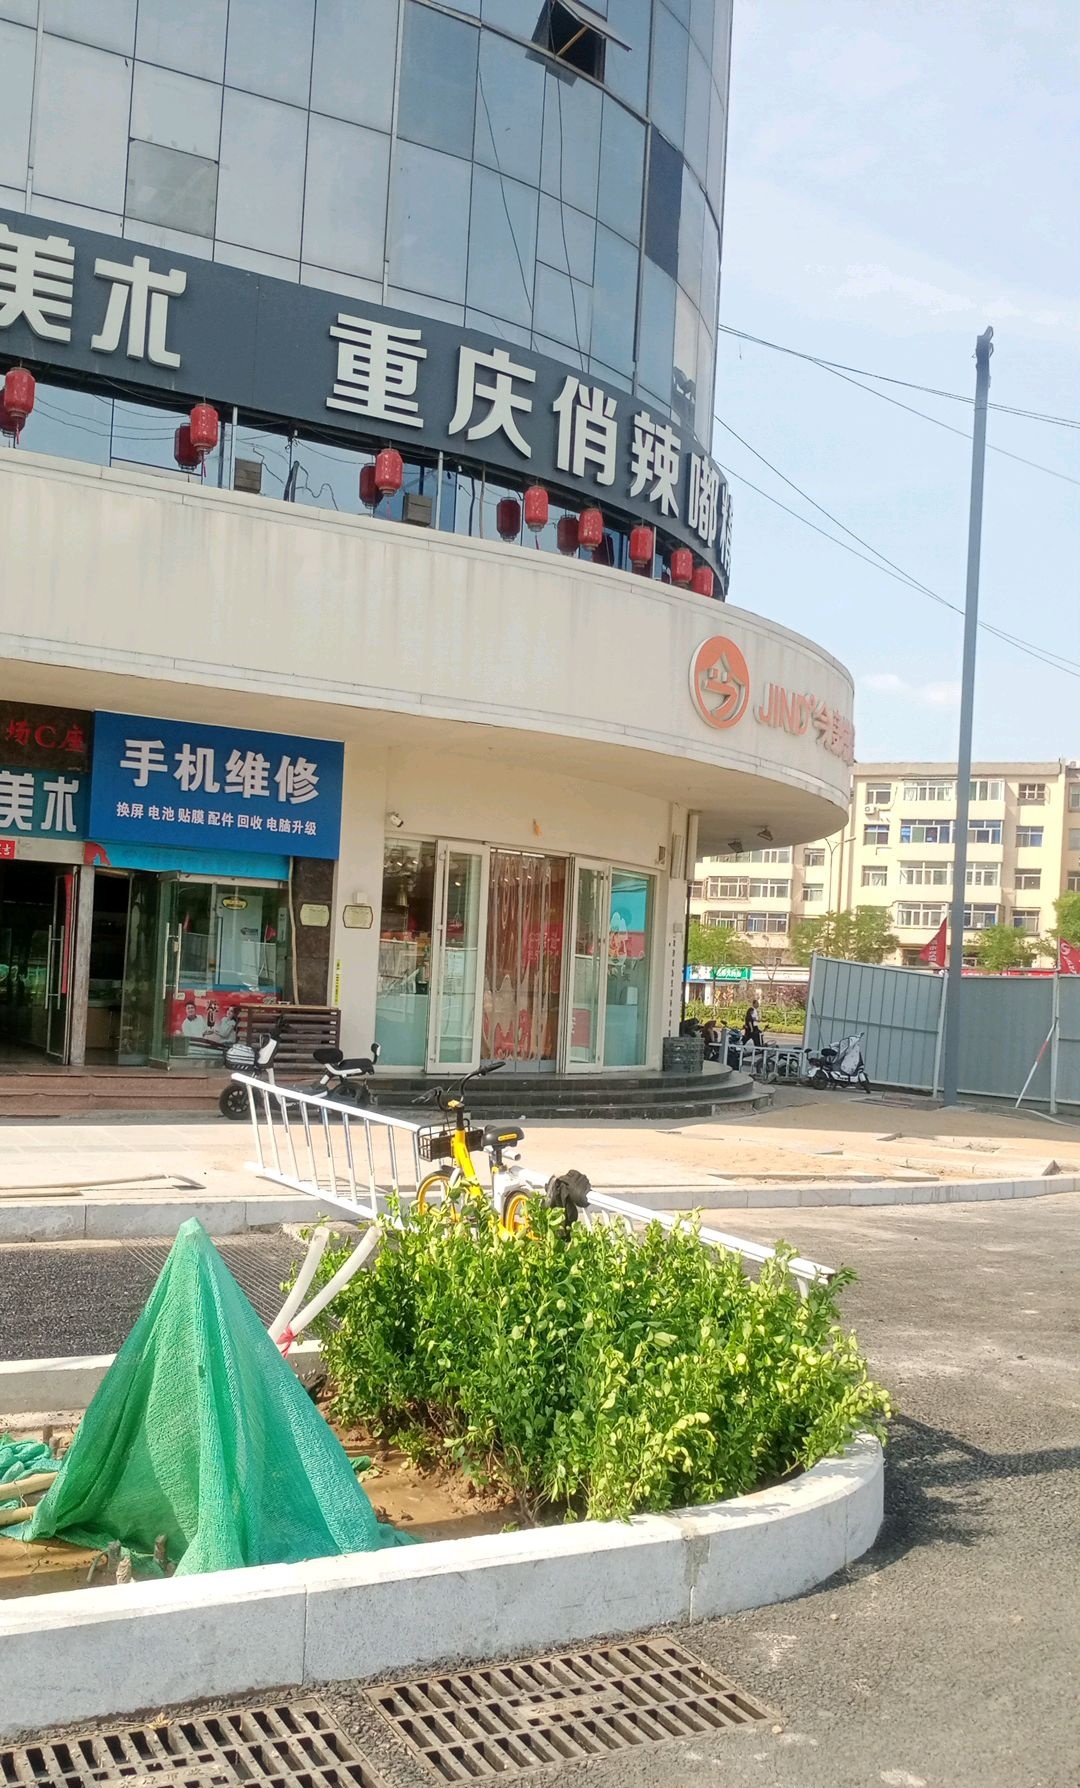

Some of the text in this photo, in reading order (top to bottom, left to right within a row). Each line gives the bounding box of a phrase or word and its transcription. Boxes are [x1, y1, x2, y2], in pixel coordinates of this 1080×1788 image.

[0, 223, 187, 369] 美术
[0, 770, 79, 833] 美术
[120, 739, 320, 805] 手机维修
[116, 802, 317, 837] 换屏 电池 贴膜 配件 回收 电脑升级
